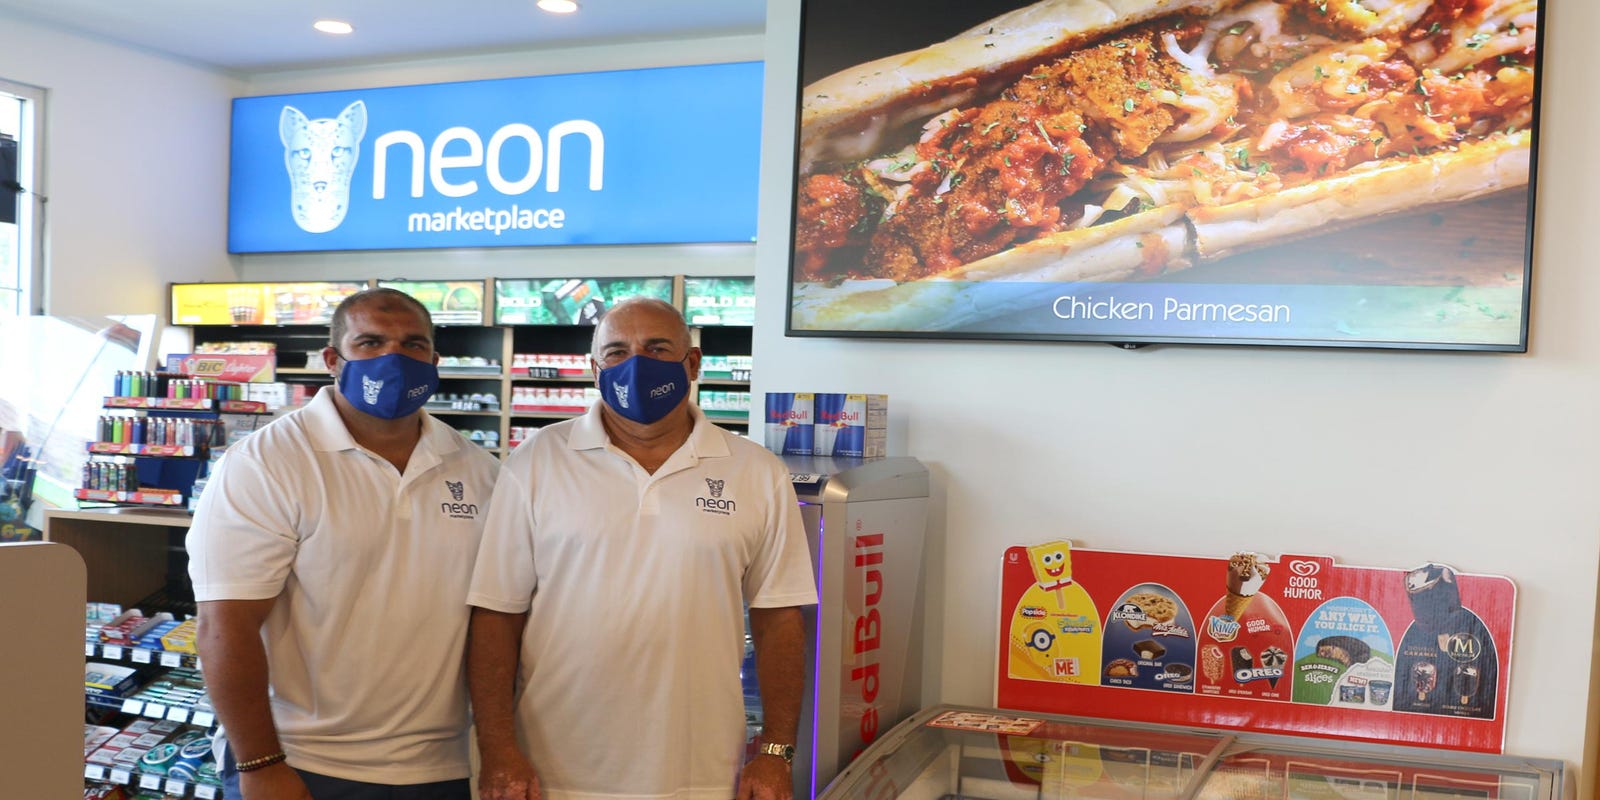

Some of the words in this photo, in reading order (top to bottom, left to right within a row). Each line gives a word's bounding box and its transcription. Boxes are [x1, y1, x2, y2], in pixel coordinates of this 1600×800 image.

[372, 119, 604, 200] neon
[408, 205, 565, 236] marketplace
[1052, 296, 1154, 320] Chicken
[1163, 297, 1291, 323] Parmesan
[408, 384, 429, 399] neon
[650, 382, 676, 399] neon
[770, 410, 789, 419] Red
[790, 410, 808, 419] Bull
[821, 411, 840, 420] Red
[841, 411, 859, 421] Bull
[441, 503, 479, 515] neon
[695, 497, 736, 512] neon
[1289, 576, 1318, 589] GOOD
[853, 533, 884, 655] Bull
[1283, 587, 1322, 600] HUMOR
[1022, 608, 1046, 617] Popsicle
[1113, 611, 1147, 622] KLONDIKE
[1319, 610, 1346, 621] ANY
[1347, 612, 1376, 624] WAY
[1211, 617, 1239, 635] KING
[1246, 619, 1266, 628] GOOD
[1247, 625, 1271, 633] HUMOR
[1314, 620, 1336, 630] YOU
[1336, 622, 1366, 632] SLICE
[1366, 624, 1380, 633] IT.
[1452, 636, 1473, 654] M
[1055, 662, 1075, 675] ME
[1236, 668, 1283, 681] OREO
[1154, 673, 1181, 681] OREO
[1304, 672, 1333, 684] slices
[1349, 676, 1367, 686] NEW!
[851, 663, 880, 762] ed
